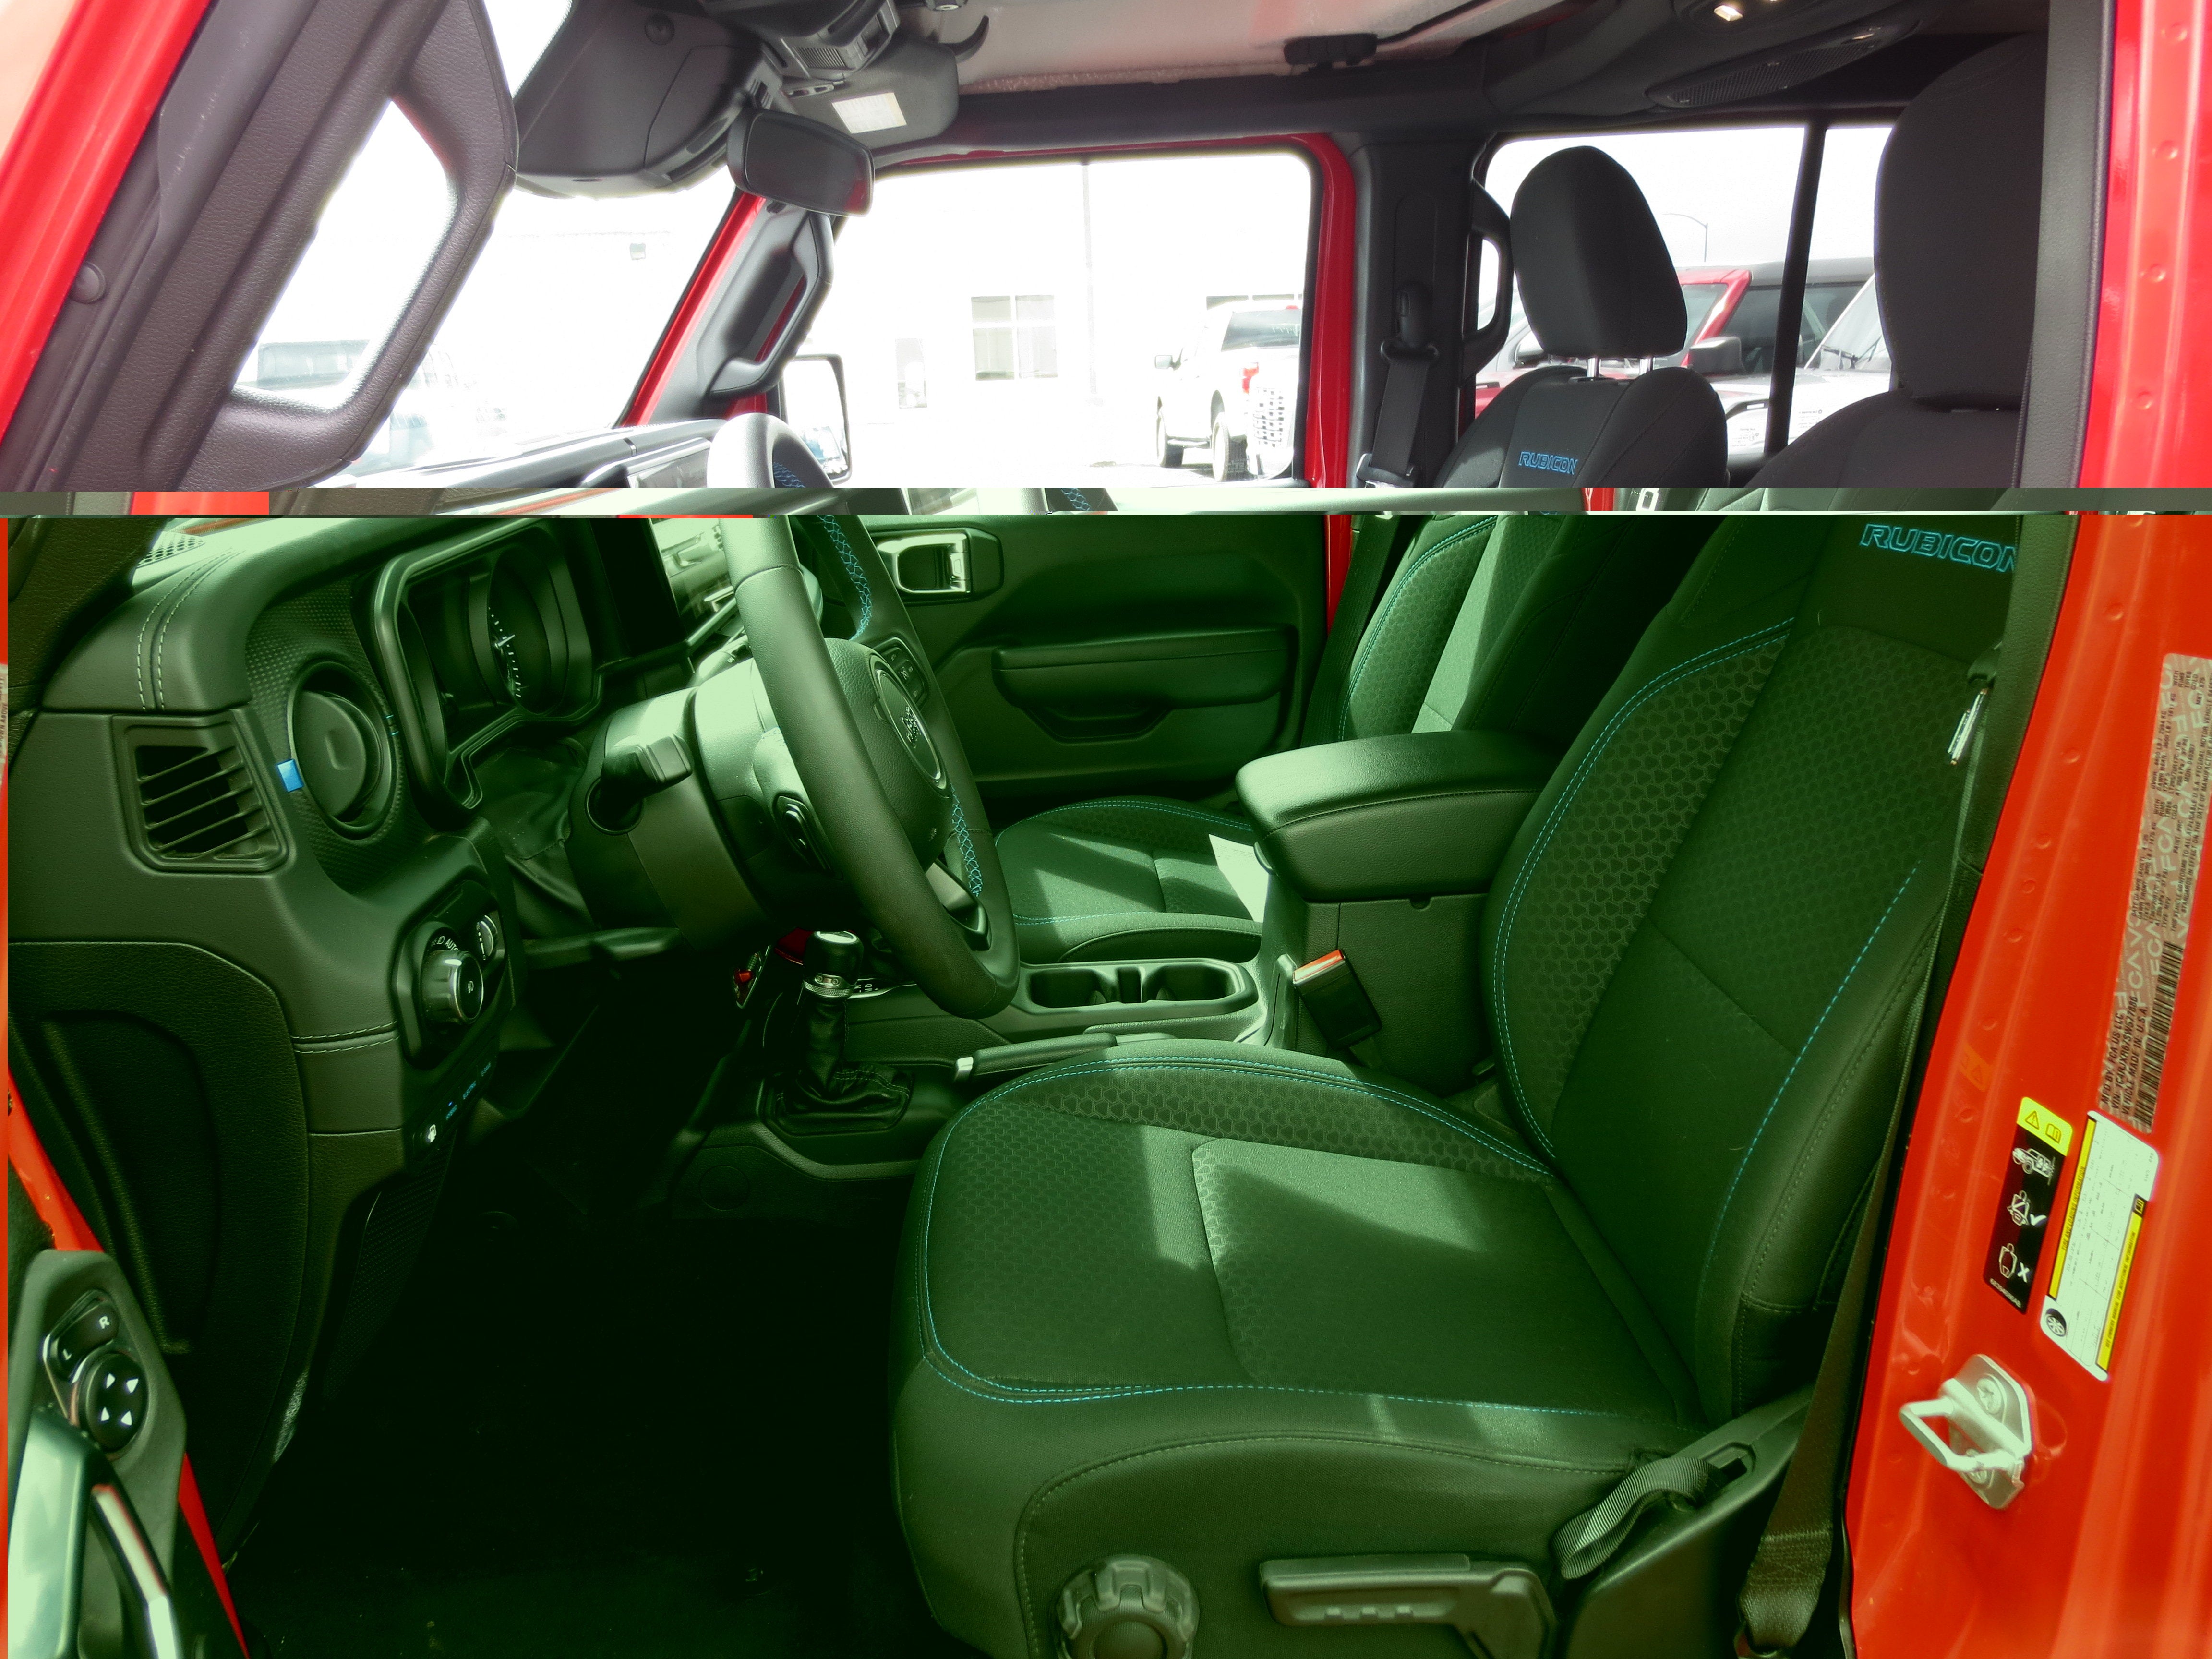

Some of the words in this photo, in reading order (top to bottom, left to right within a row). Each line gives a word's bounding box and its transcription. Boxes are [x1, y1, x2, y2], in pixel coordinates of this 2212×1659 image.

[1518, 451, 1579, 475] RUBICON
[1859, 523, 2018, 573] RUBICON
[2122, 1078, 2134, 1116] VEHICLE
[2072, 1165, 2085, 1202] INFORMATION
[99, 1315, 110, 1329] R
[62, 1348, 72, 1361] L
